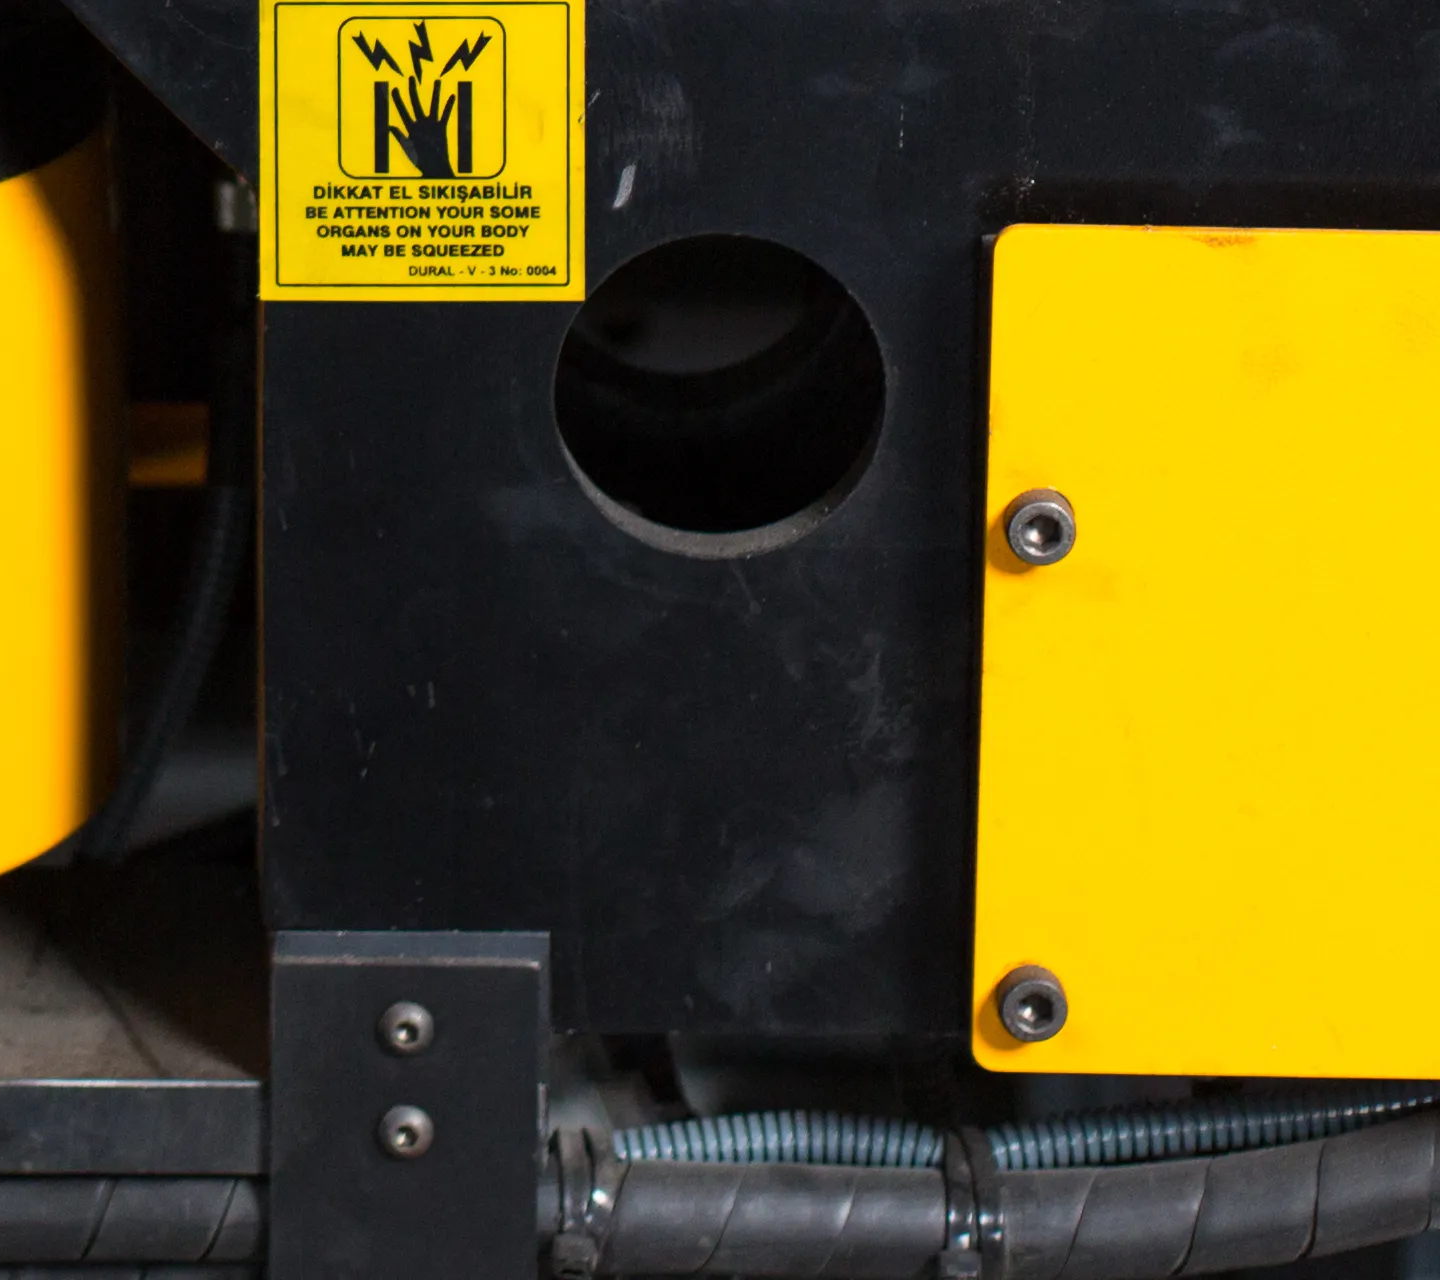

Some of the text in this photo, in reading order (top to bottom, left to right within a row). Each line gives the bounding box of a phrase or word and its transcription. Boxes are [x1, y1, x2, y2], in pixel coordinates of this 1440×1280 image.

[313, 181, 533, 204] DİKKAT EL SIKIŞABİLİR
[305, 206, 541, 220] BE ATTENTION YOUR SOME
[316, 225, 530, 239] ORGANS ON YOUR BODY
[341, 244, 506, 258] MAY BE SQUEEZED
[408, 265, 455, 277] DURAL
[467, 265, 477, 277] V
[489, 266, 496, 277] 3
[526, 266, 557, 277] 0004
